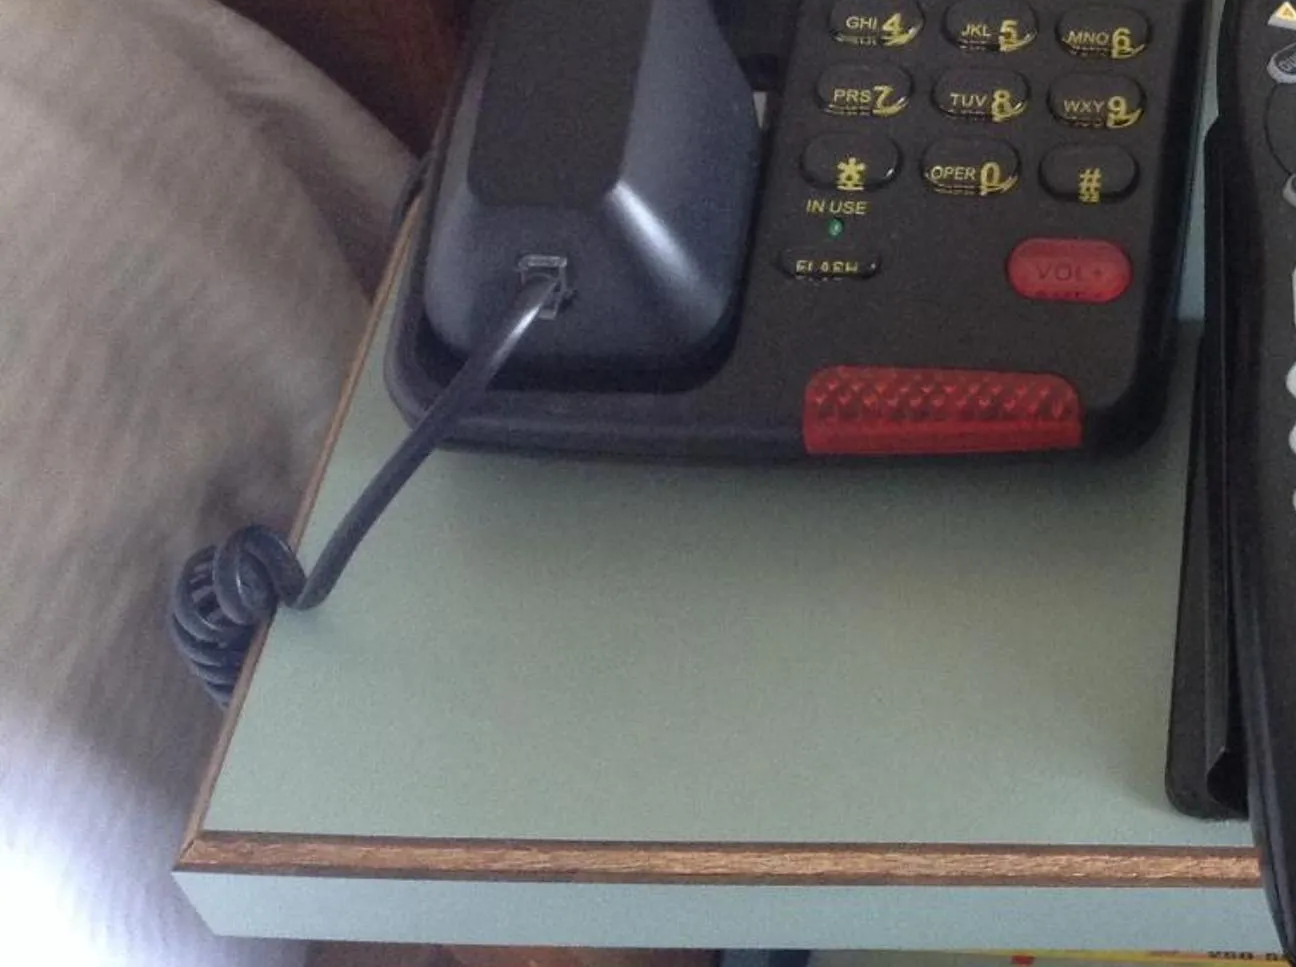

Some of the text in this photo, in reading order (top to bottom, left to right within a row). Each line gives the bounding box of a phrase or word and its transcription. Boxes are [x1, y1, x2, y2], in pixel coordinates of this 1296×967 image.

[846, 13, 903, 38] GHI 4
[961, 19, 1021, 46] JKL 5
[1067, 27, 1132, 52] MNO 6
[833, 85, 895, 112] PRS 7
[949, 89, 1012, 115] TUV 8
[1062, 95, 1128, 119] WXY 9
[930, 165, 976, 181] OPER
[806, 199, 868, 215] IN USE
